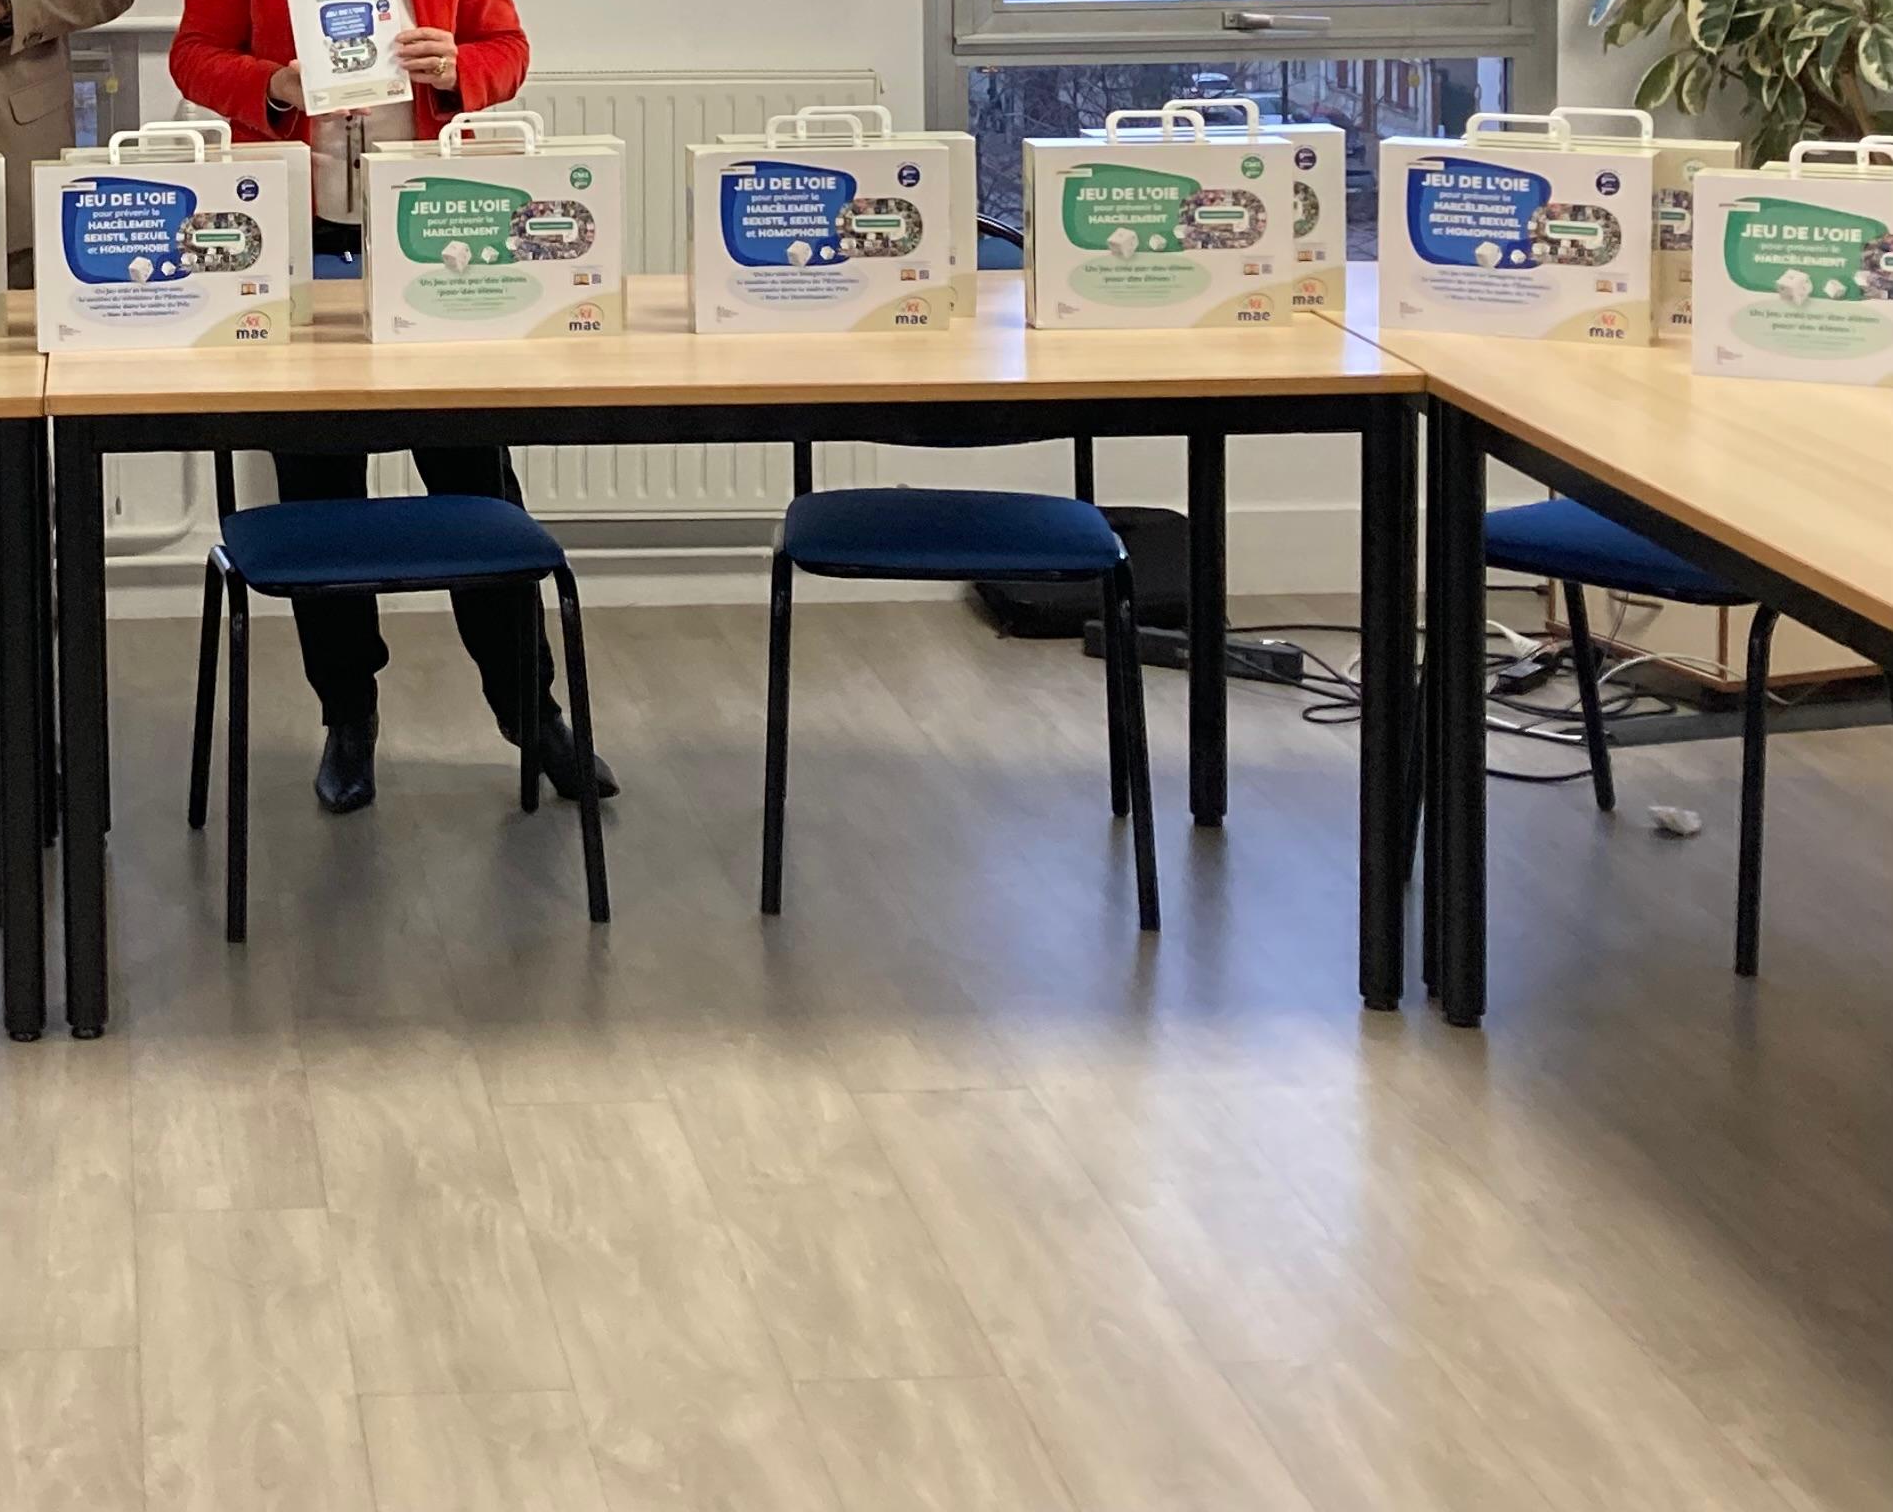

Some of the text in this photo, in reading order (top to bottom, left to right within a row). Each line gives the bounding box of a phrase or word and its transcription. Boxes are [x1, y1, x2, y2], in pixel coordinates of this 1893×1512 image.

[734, 176, 837, 191] JEU DE L'OIE
[1420, 172, 1531, 192] JEU DE L'OIE
[75, 191, 177, 207] JEU DE L'OIE
[1075, 186, 1180, 201] JEU DE L'OIE
[410, 198, 511, 215] JEU DE L'OIE
[746, 202, 826, 214] HARCÈLEMENT
[87, 218, 166, 230] HARCÈLEMENT
[789, 214, 830, 226] SEXUEL
[130, 231, 171, 241] SEXUEL
[1740, 223, 1778, 238] JEU
[1782, 224, 1809, 240] DE
[1292, 295, 1325, 306] mae
[895, 313, 928, 325] mae
[1237, 310, 1271, 322] mae
[568, 320, 601, 332] mae
[236, 328, 268, 340] mae
[1589, 326, 1625, 339] mae
